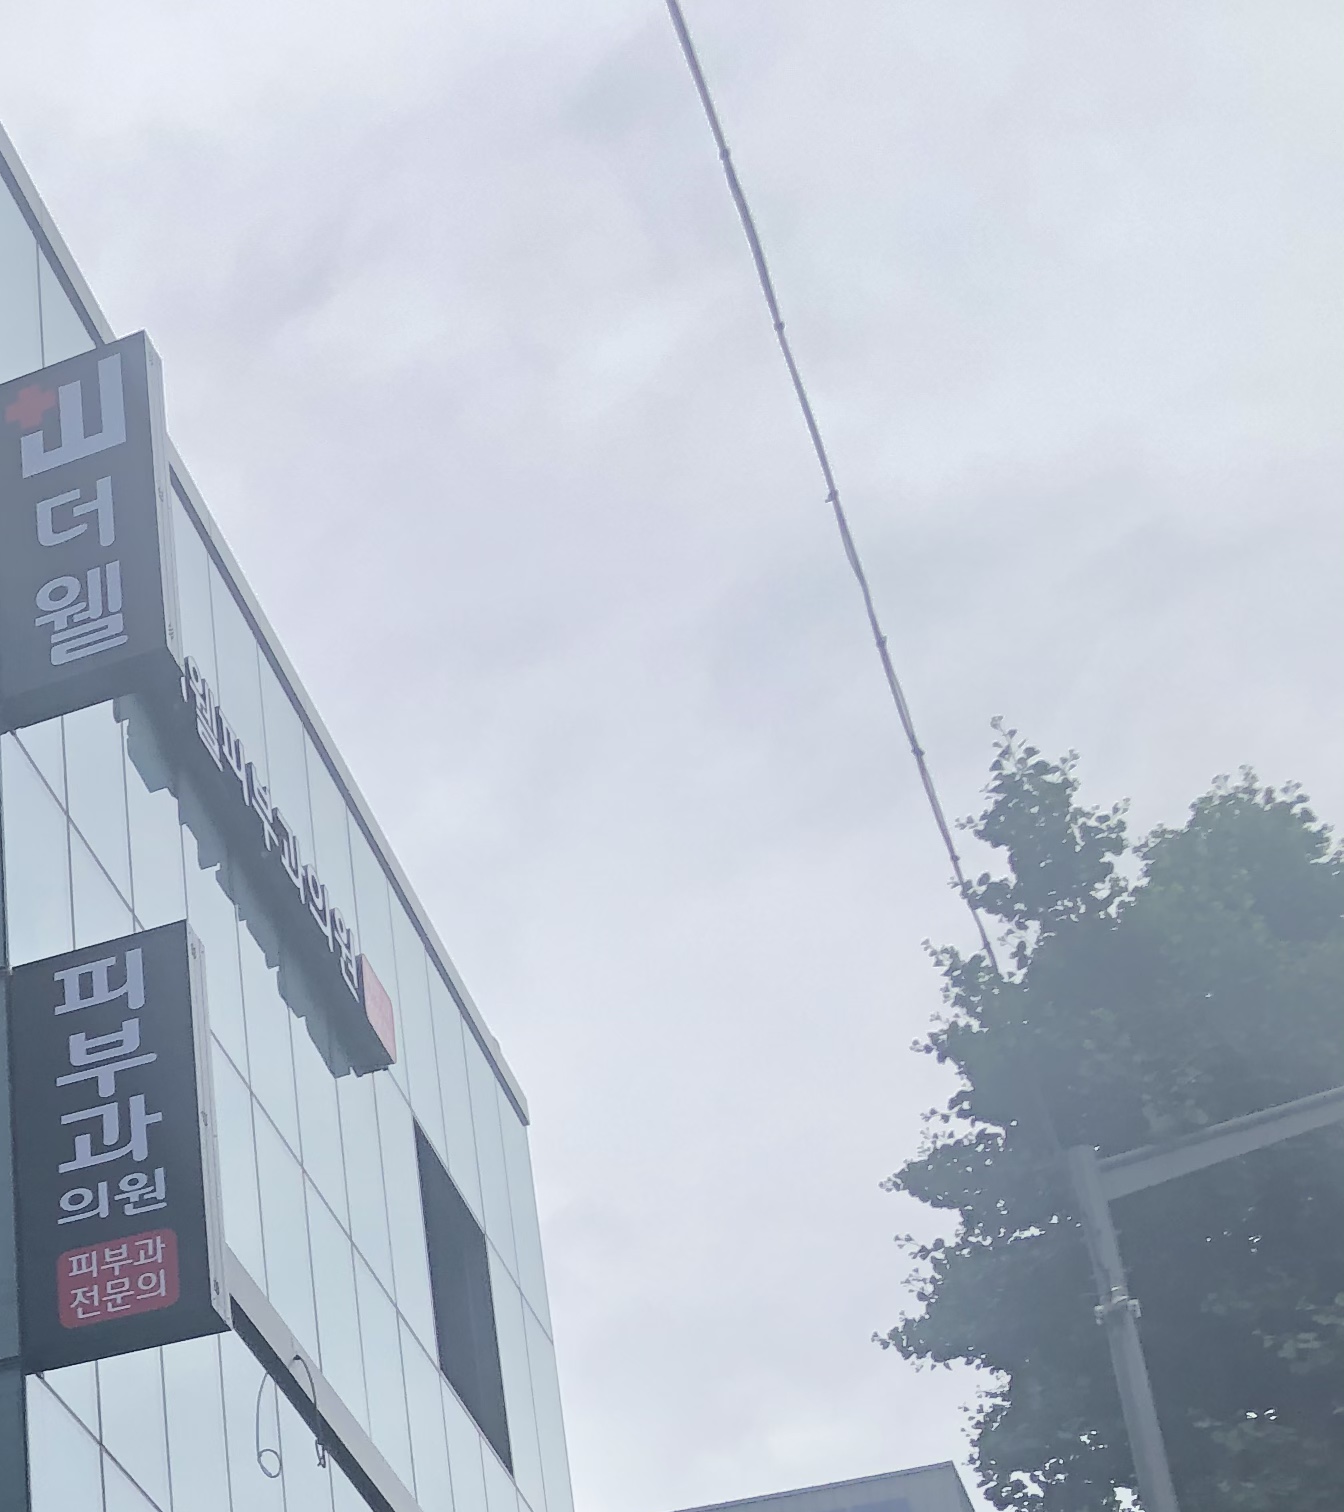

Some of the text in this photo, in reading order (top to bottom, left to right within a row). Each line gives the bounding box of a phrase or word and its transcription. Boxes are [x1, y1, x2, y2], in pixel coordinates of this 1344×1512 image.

[181, 655, 360, 1003] 웰피부과의원
[68, 1235, 166, 1279] 피부과
[70, 1269, 167, 1321] 전문의
